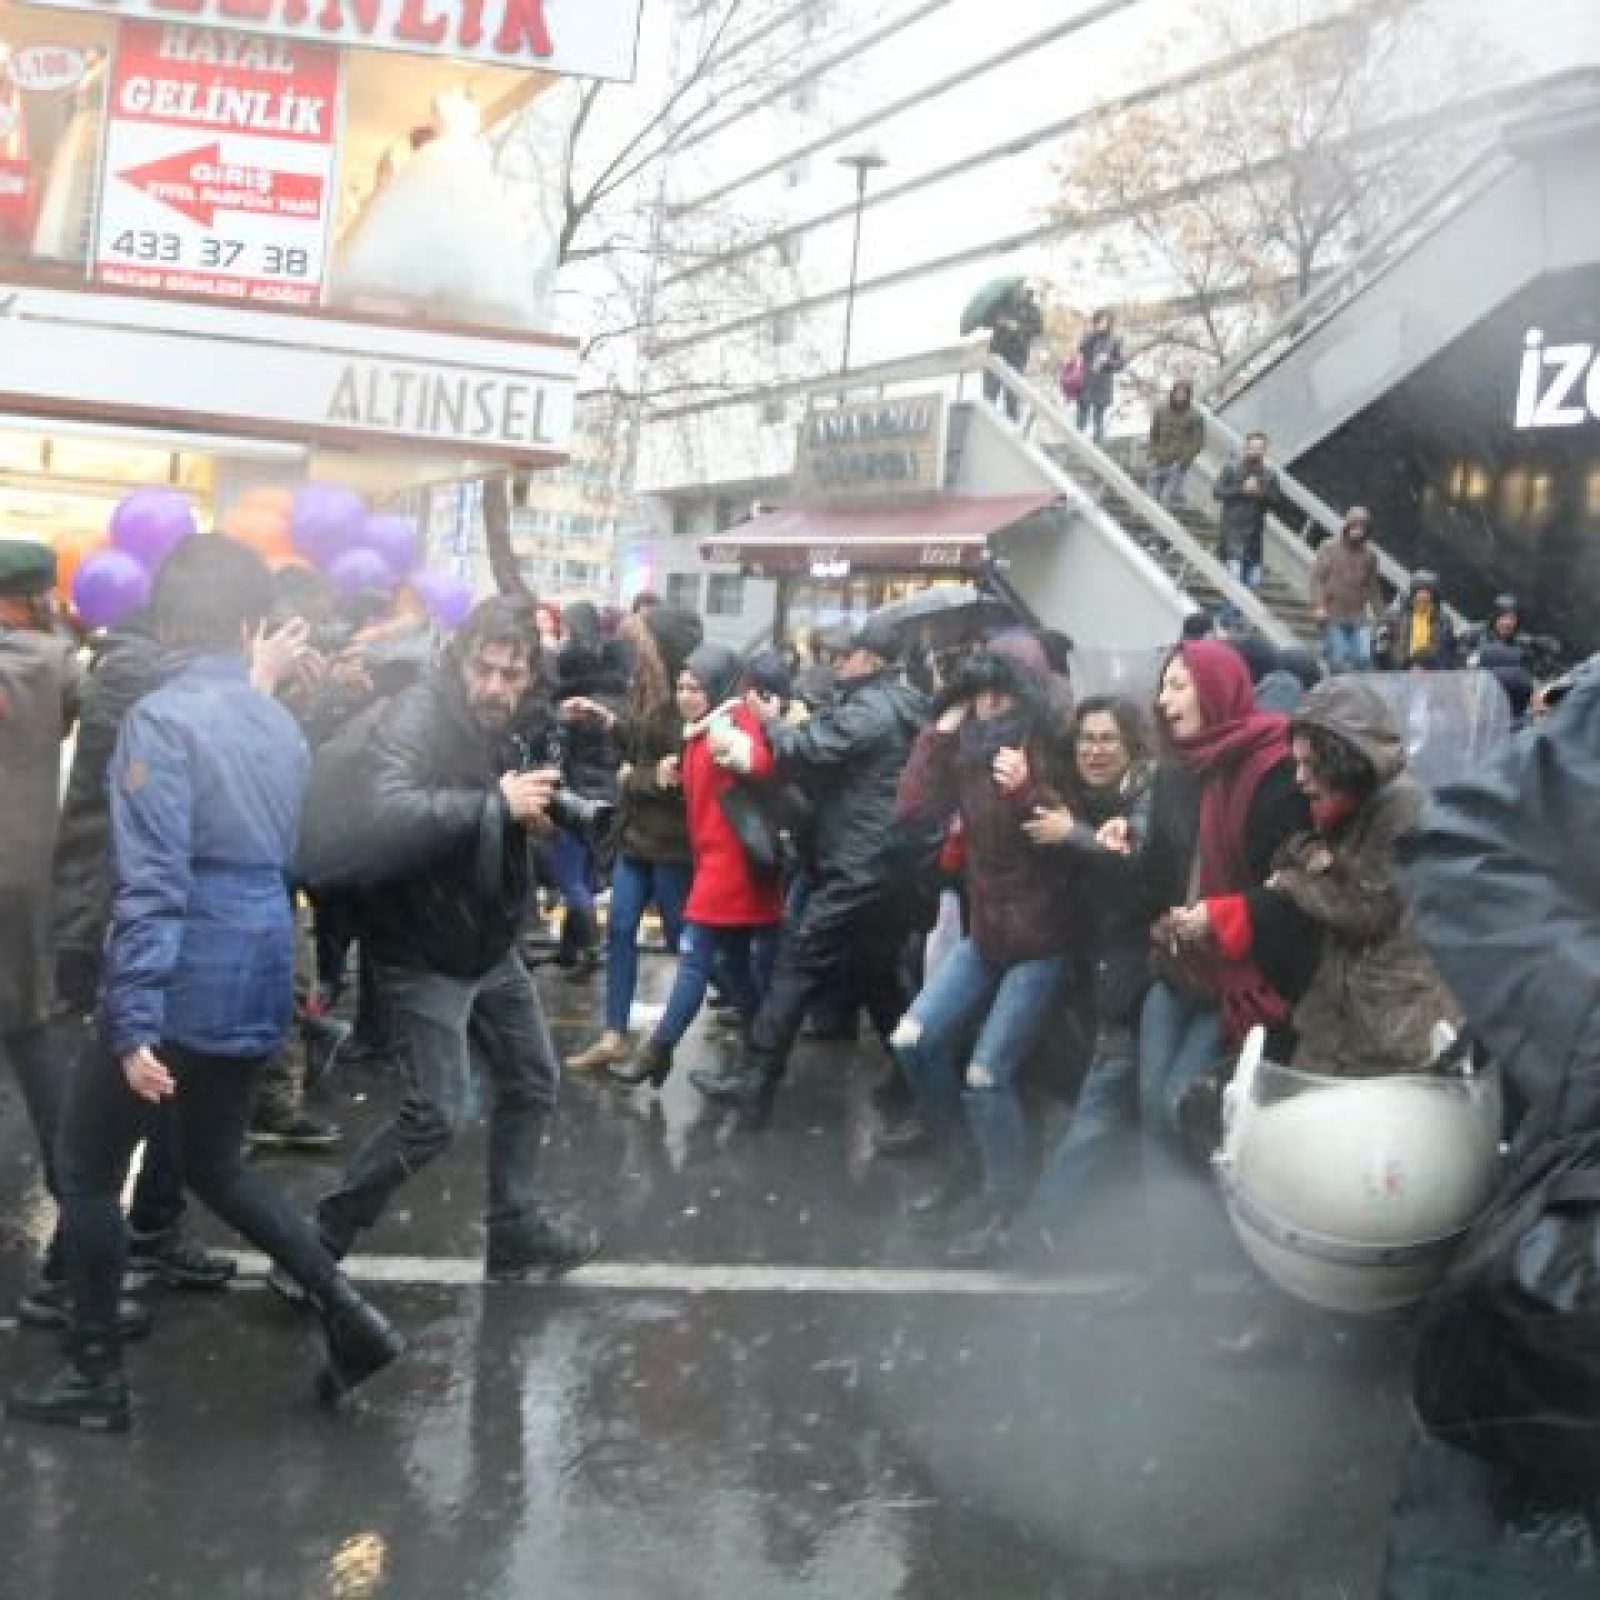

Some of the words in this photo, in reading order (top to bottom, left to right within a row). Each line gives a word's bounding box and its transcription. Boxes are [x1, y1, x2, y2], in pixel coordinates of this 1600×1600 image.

[158, 25, 294, 73] HAYAL
[119, 75, 325, 134] GELİNLİK
[110, 228, 182, 261] 433
[201, 237, 245, 268] 37
[263, 245, 309, 276] 38
[326, 364, 554, 444] ALTINSEL
